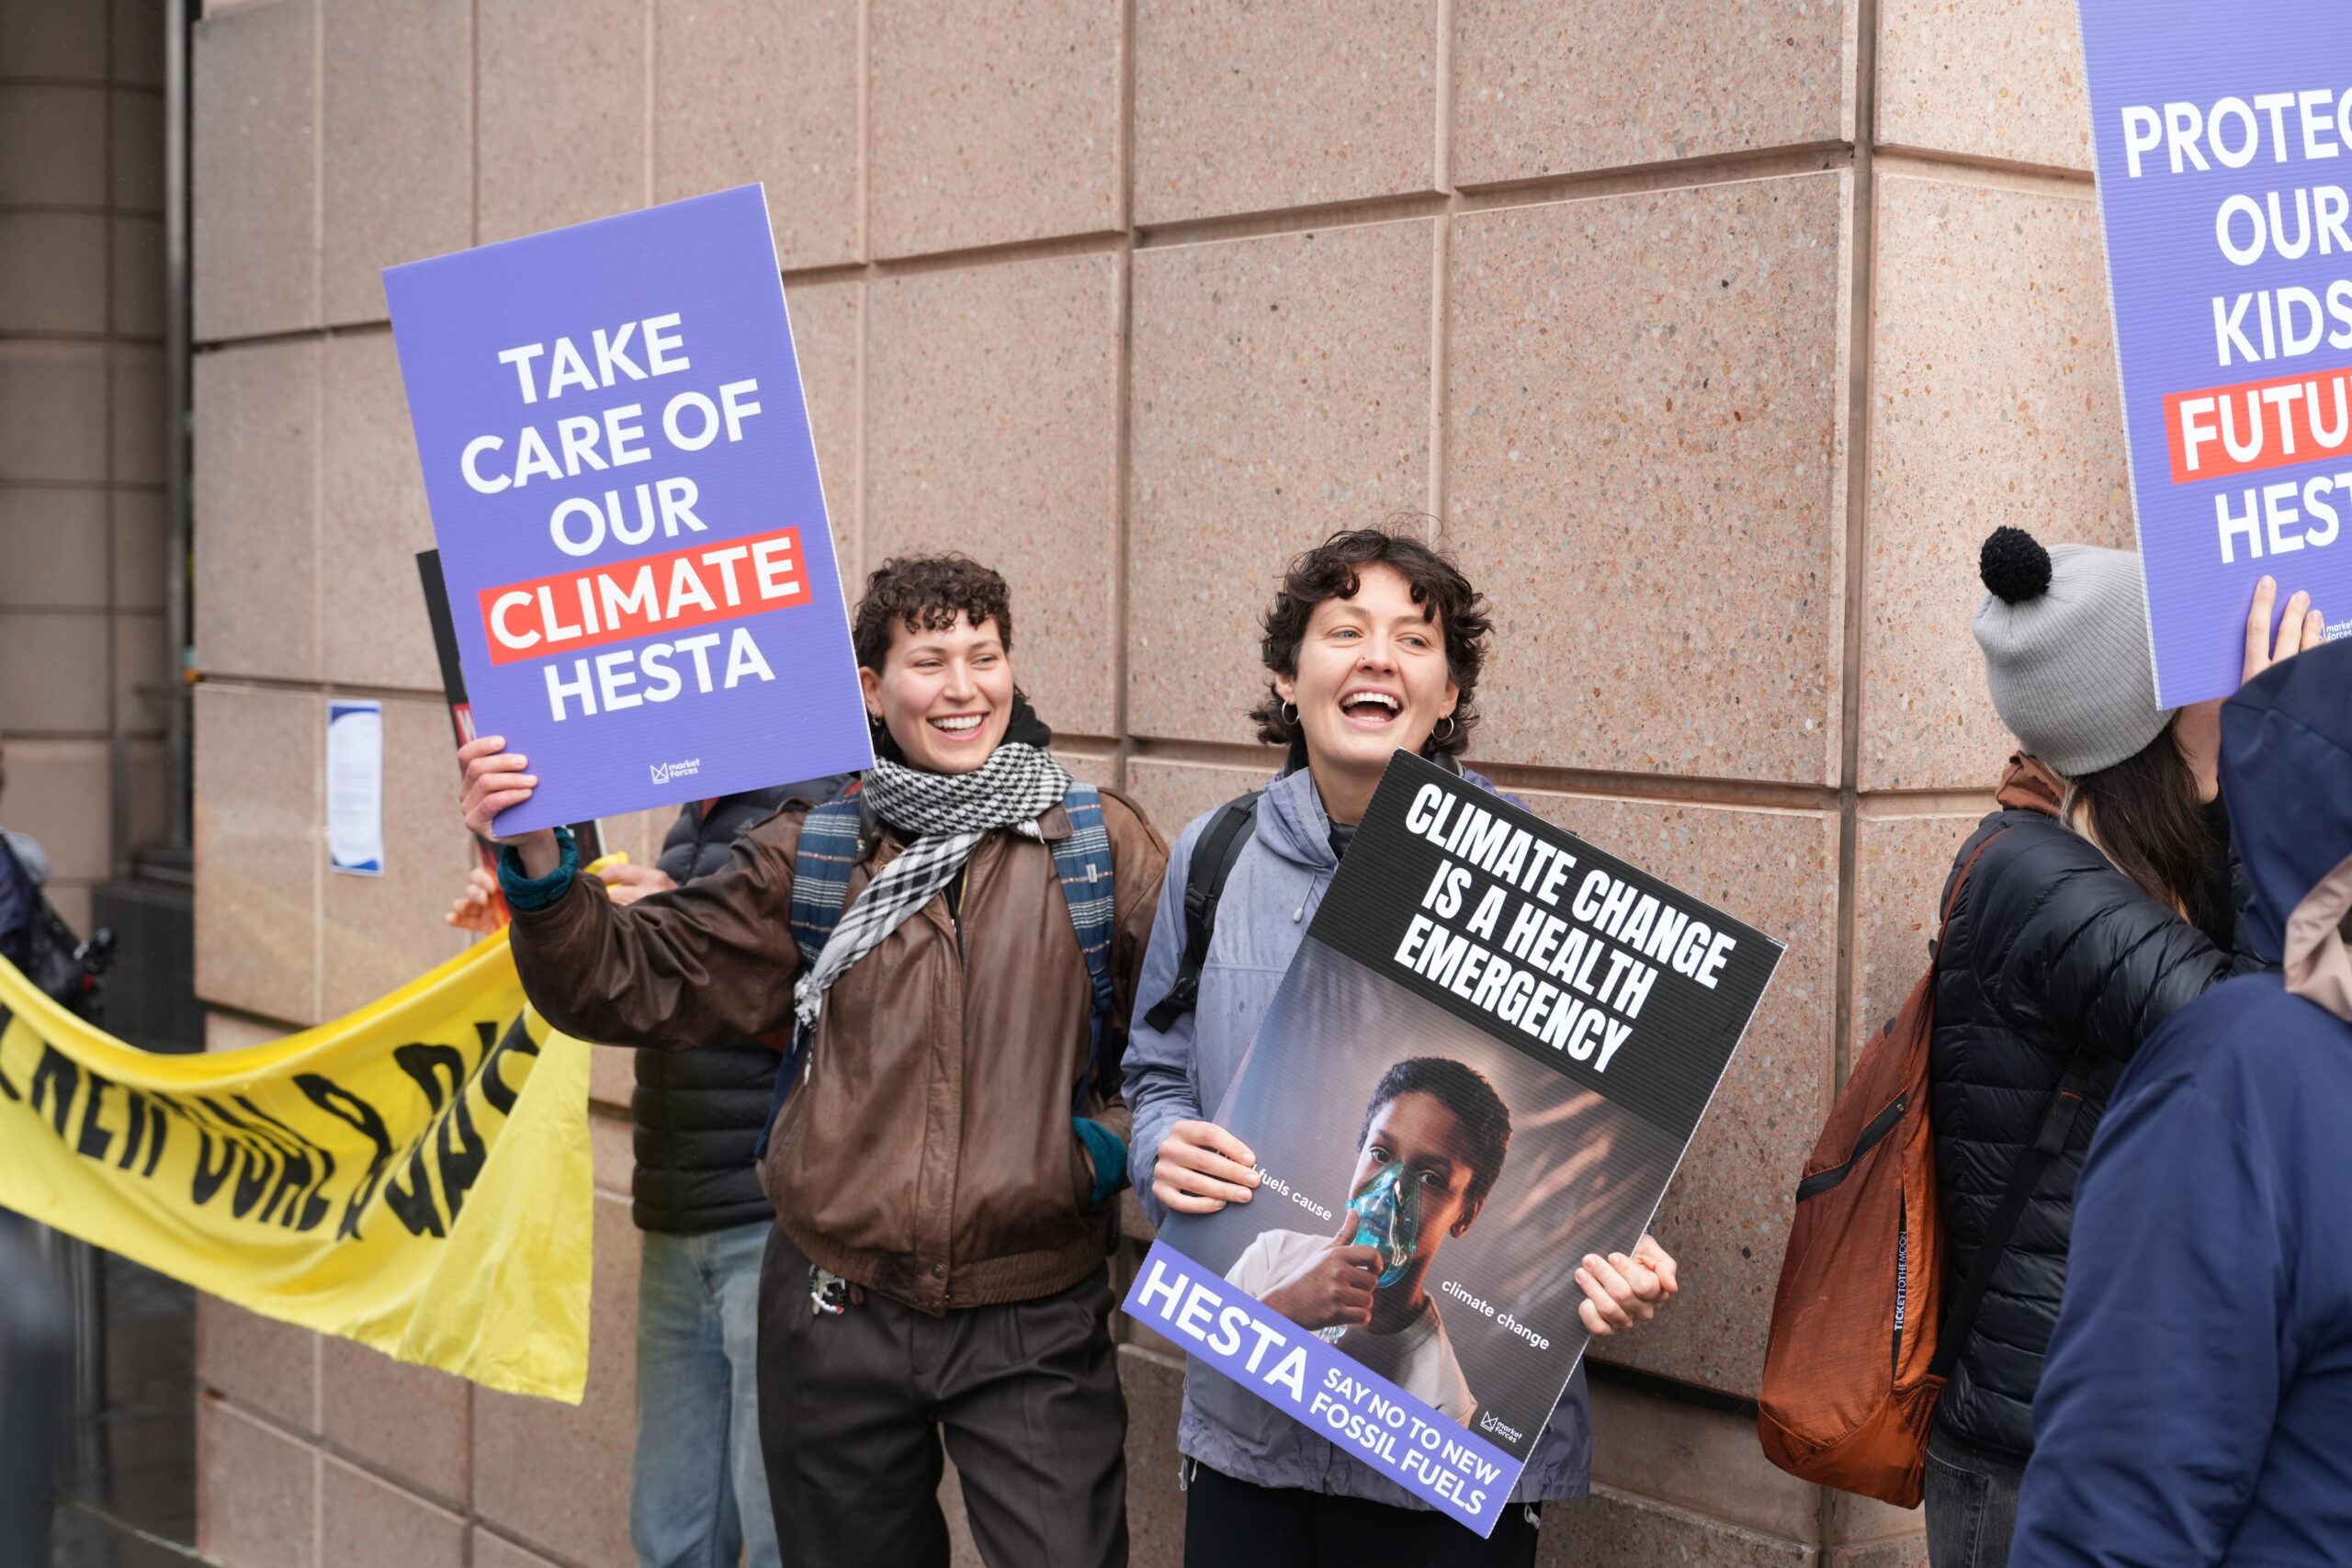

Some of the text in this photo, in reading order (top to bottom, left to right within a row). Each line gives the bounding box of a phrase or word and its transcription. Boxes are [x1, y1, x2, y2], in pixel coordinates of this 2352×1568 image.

[2215, 185, 2352, 266] OUR
[498, 312, 691, 404] TAKE
[2211, 279, 2352, 367] KIDS
[460, 378, 762, 494] CARE OF
[2179, 375, 2352, 471] FUTU
[549, 476, 708, 557] OUR
[491, 536, 800, 649] CLIMATE
[543, 626, 776, 722] HESTA
[668, 758, 700, 771] market
[670, 767, 699, 778] forces
[1405, 783, 1737, 989] CLIMATE CHANGE
[1420, 859, 1659, 1020] IS A HEALTH
[1394, 913, 1633, 1073] EMERGENCY
[1292, 1191, 1332, 1221] cause
[1136, 1258, 1308, 1404] HESTA
[1442, 1280, 1550, 1350] climate change
[1309, 1391, 1487, 1515] FOSSIL FUELS
[1323, 1368, 1501, 1485] SAY NO TO NEW
[1494, 1427, 1517, 1443] forces
[1496, 1421, 1522, 1440] market
